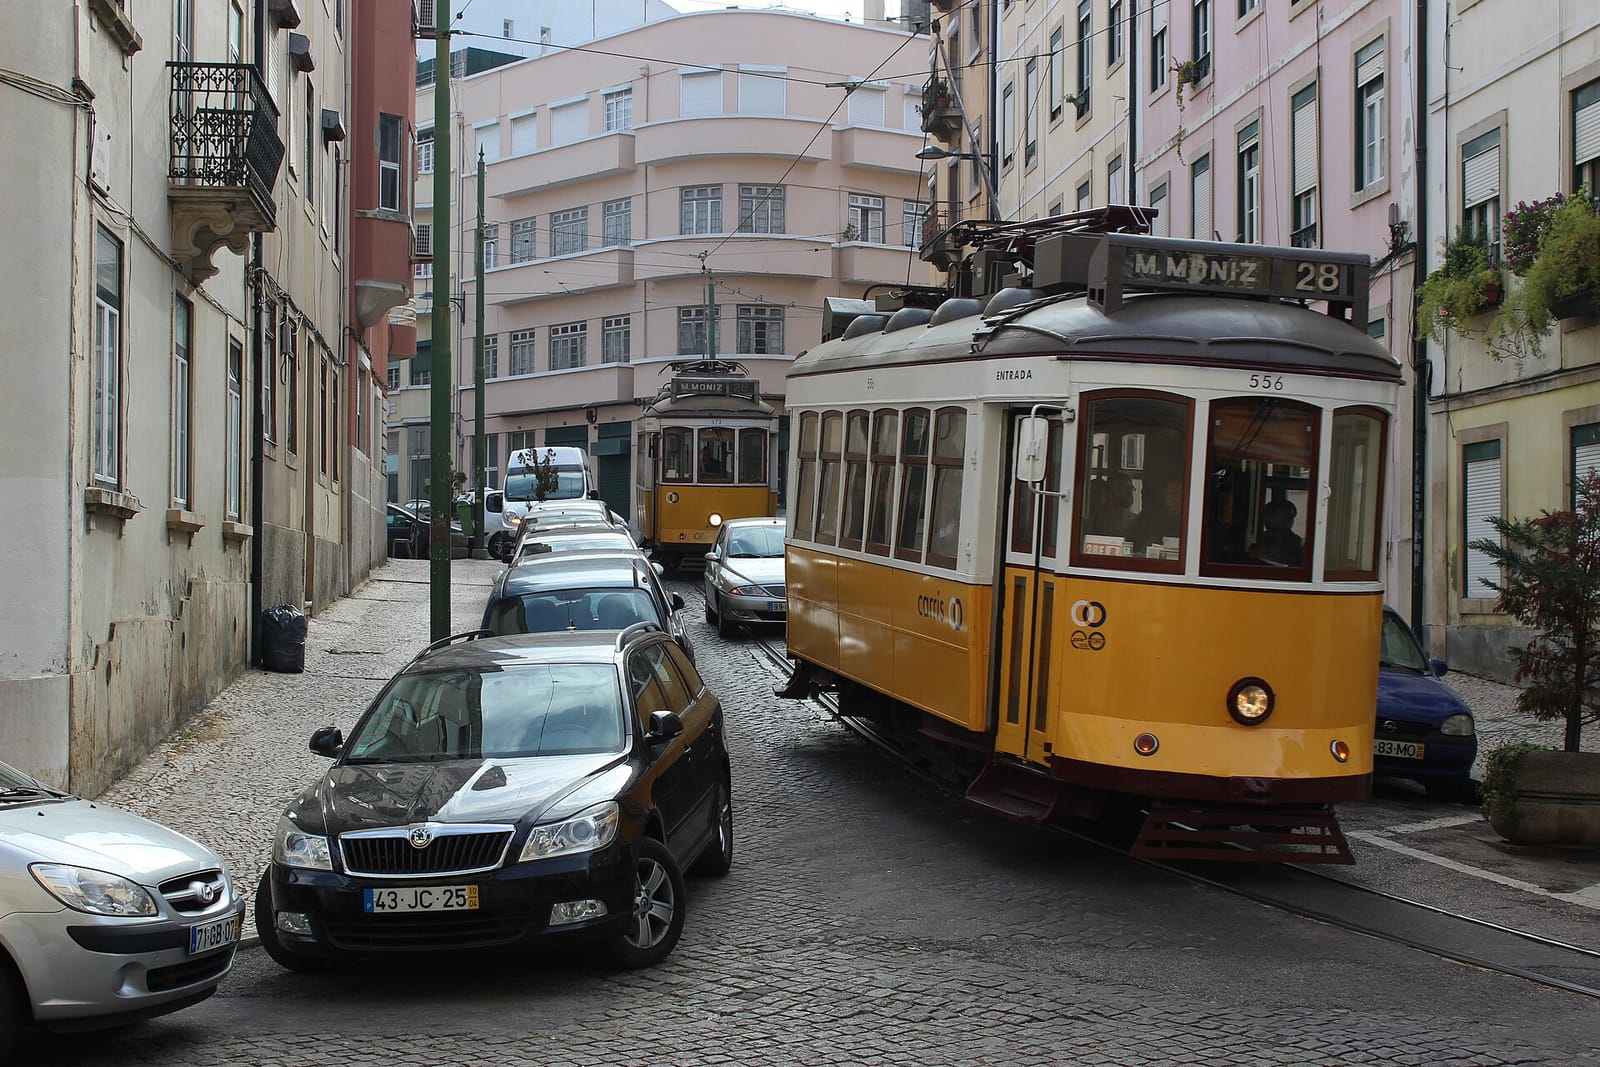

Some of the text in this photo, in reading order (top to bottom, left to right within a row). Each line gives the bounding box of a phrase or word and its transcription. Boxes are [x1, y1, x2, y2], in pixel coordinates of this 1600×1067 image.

[1135, 253, 1257, 283] M. MONIZ
[1296, 262, 1339, 292] 28
[996, 369, 1032, 381] ENTRADA
[1249, 374, 1284, 391] 556
[691, 383, 723, 391] MONIZ
[917, 590, 945, 622] carris
